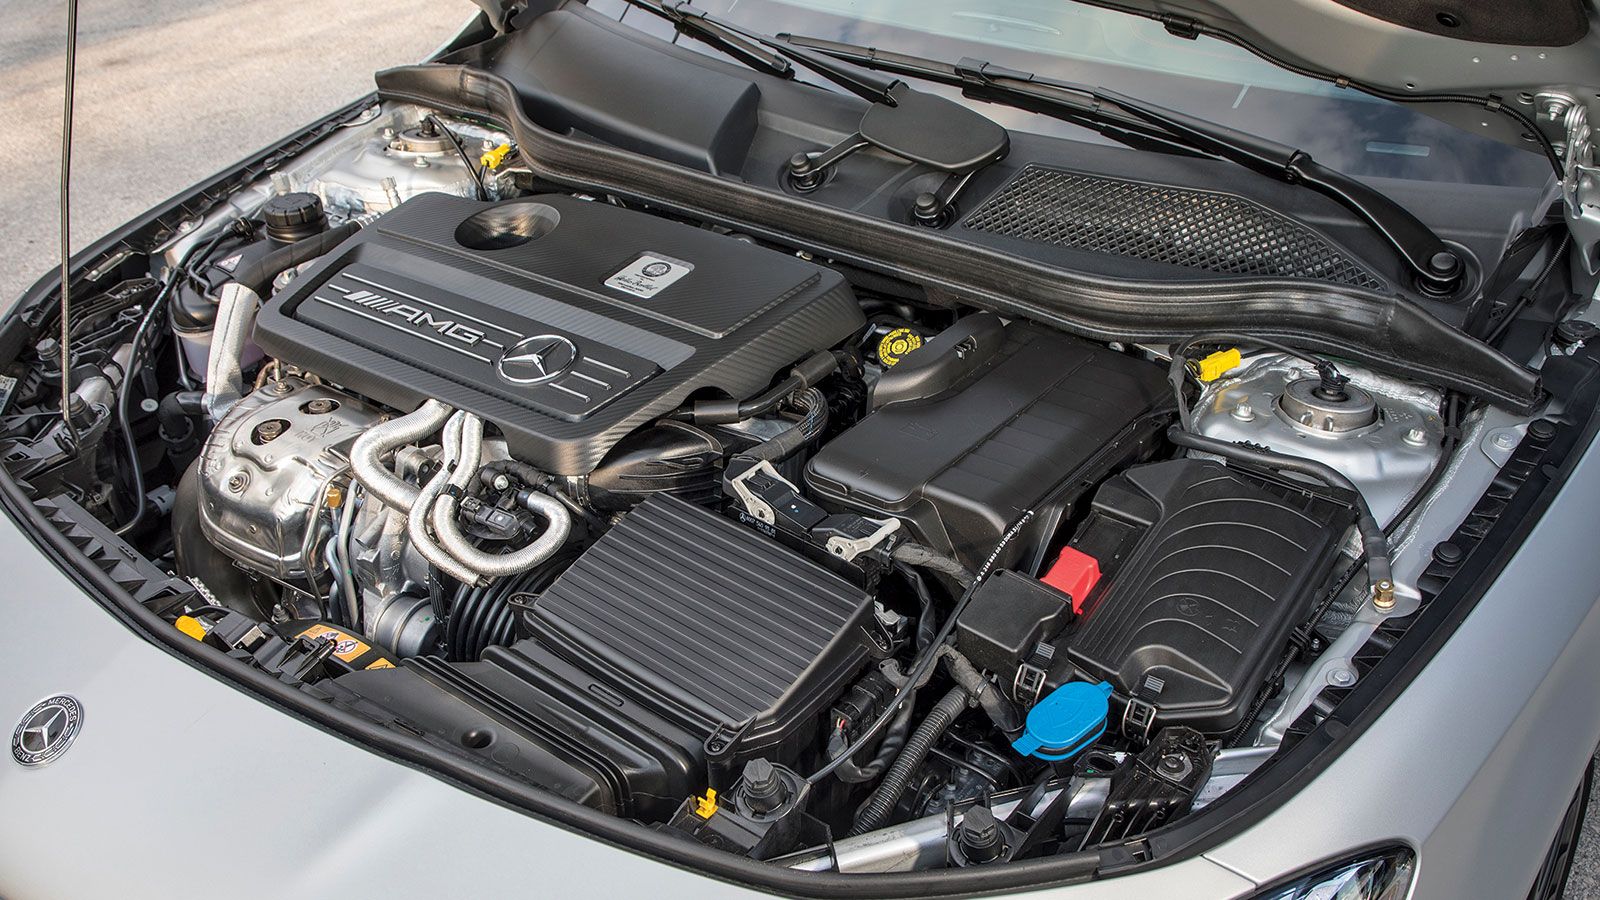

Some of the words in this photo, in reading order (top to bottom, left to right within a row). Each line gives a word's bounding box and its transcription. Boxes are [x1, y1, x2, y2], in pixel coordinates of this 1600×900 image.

[381, 304, 486, 346] AMG
[47, 697, 77, 722] MERCEDES
[14, 746, 31, 762] BENZ
